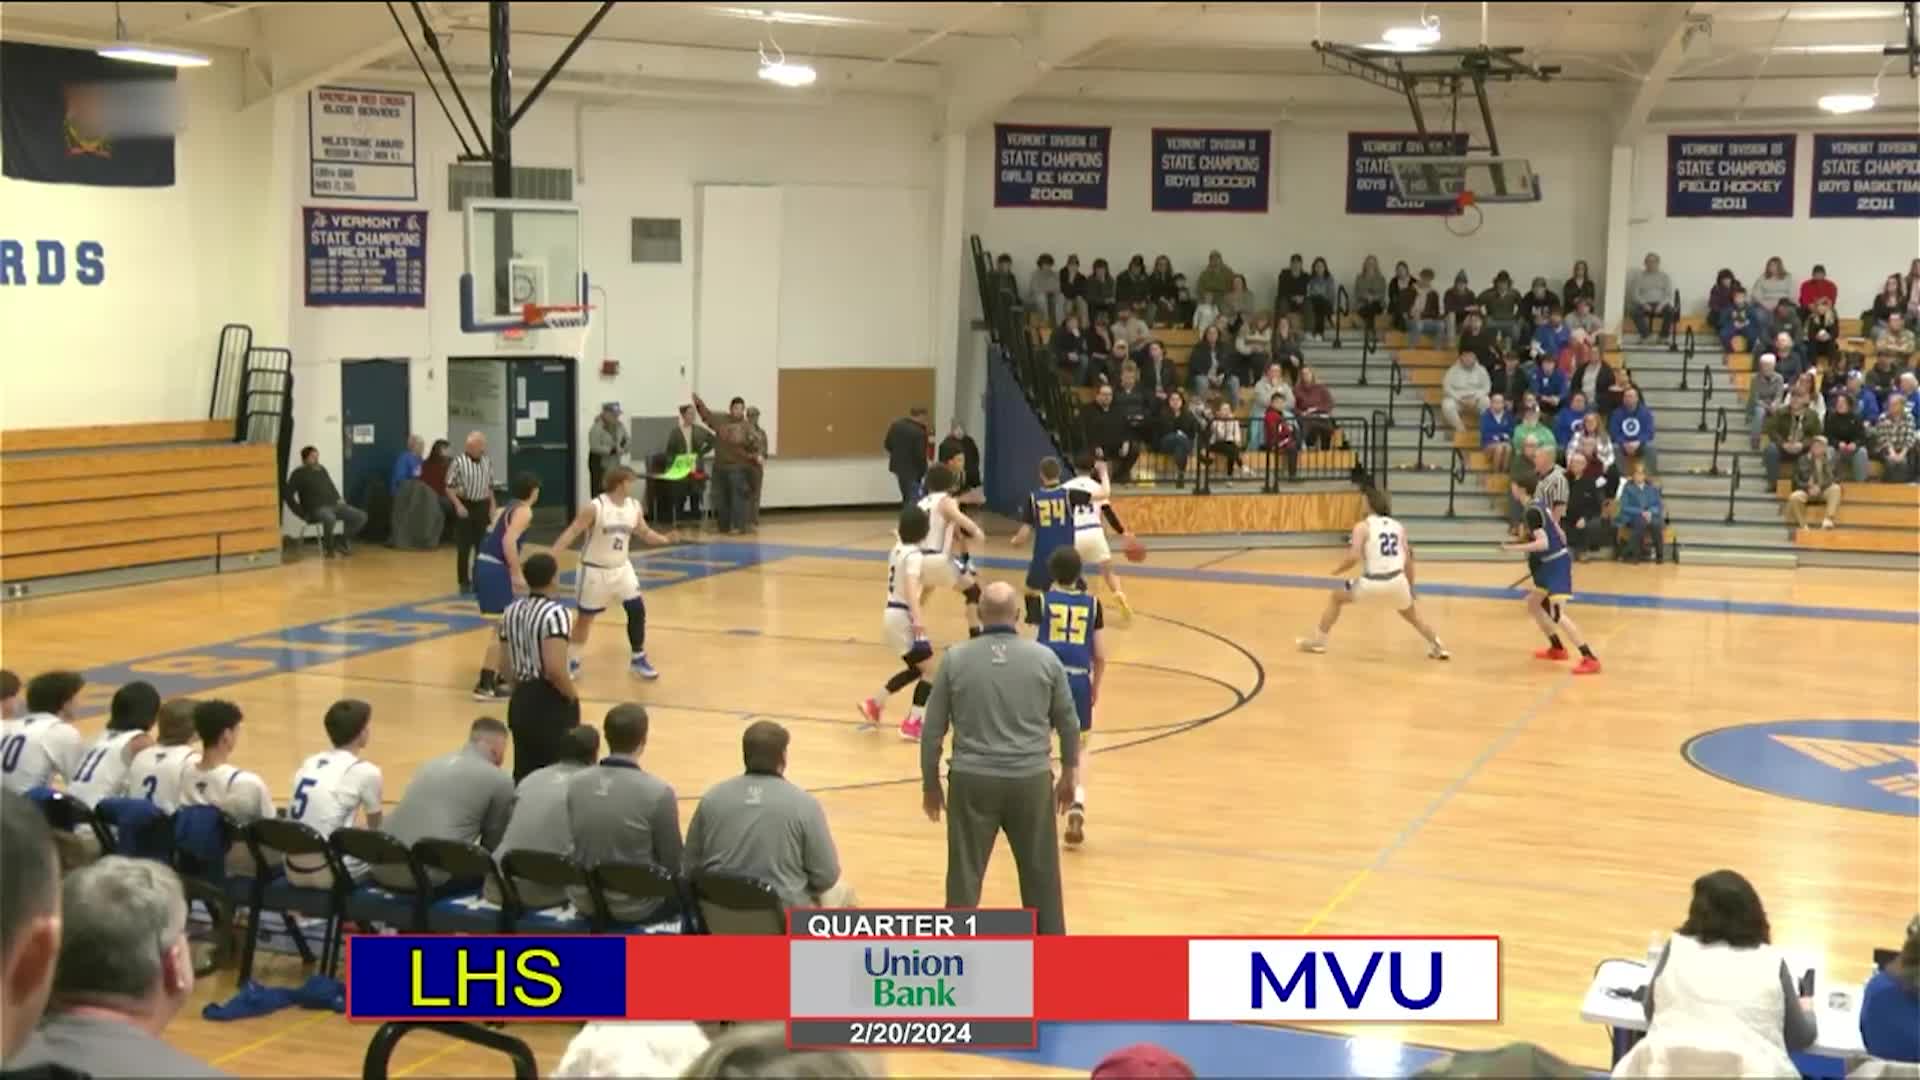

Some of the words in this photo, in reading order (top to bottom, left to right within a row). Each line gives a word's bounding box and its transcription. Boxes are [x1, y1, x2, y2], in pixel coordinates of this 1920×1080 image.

[1001, 150, 1039, 167] STATE
[1041, 151, 1103, 169] CHAMPIONS
[1161, 154, 1196, 171] STATE
[1199, 155, 1260, 172] CHAMPIONS
[1355, 157, 1392, 174] STATE
[1822, 159, 1860, 175] STATE
[1001, 168, 1032, 182] GIRLS
[1058, 171, 1101, 184] HOCKEY
[1677, 160, 1715, 176] STATE
[1718, 160, 1787, 177] CHAMPIONS
[1165, 174, 1200, 187] BOYS
[1203, 174, 1256, 188] SOCCER
[1678, 180, 1720, 193] FIELD
[1723, 180, 1782, 193] HOCKEY
[1818, 180, 1850, 193] BOYS
[1192, 191, 1230, 205] 2010
[1711, 197, 1748, 209] 2011
[1856, 197, 1895, 210] 2011
[331, 215, 401, 229] VERMONT
[311, 229, 350, 246] STATE
[355, 231, 420, 247] CHAMPIONS
[328, 246, 407, 259] WRESTLING
[0, 239, 105, 286] RDS
[1036, 499, 1067, 528] 24
[1378, 531, 1399, 556] 22
[1048, 603, 1090, 645] 25
[291, 777, 318, 820] 5
